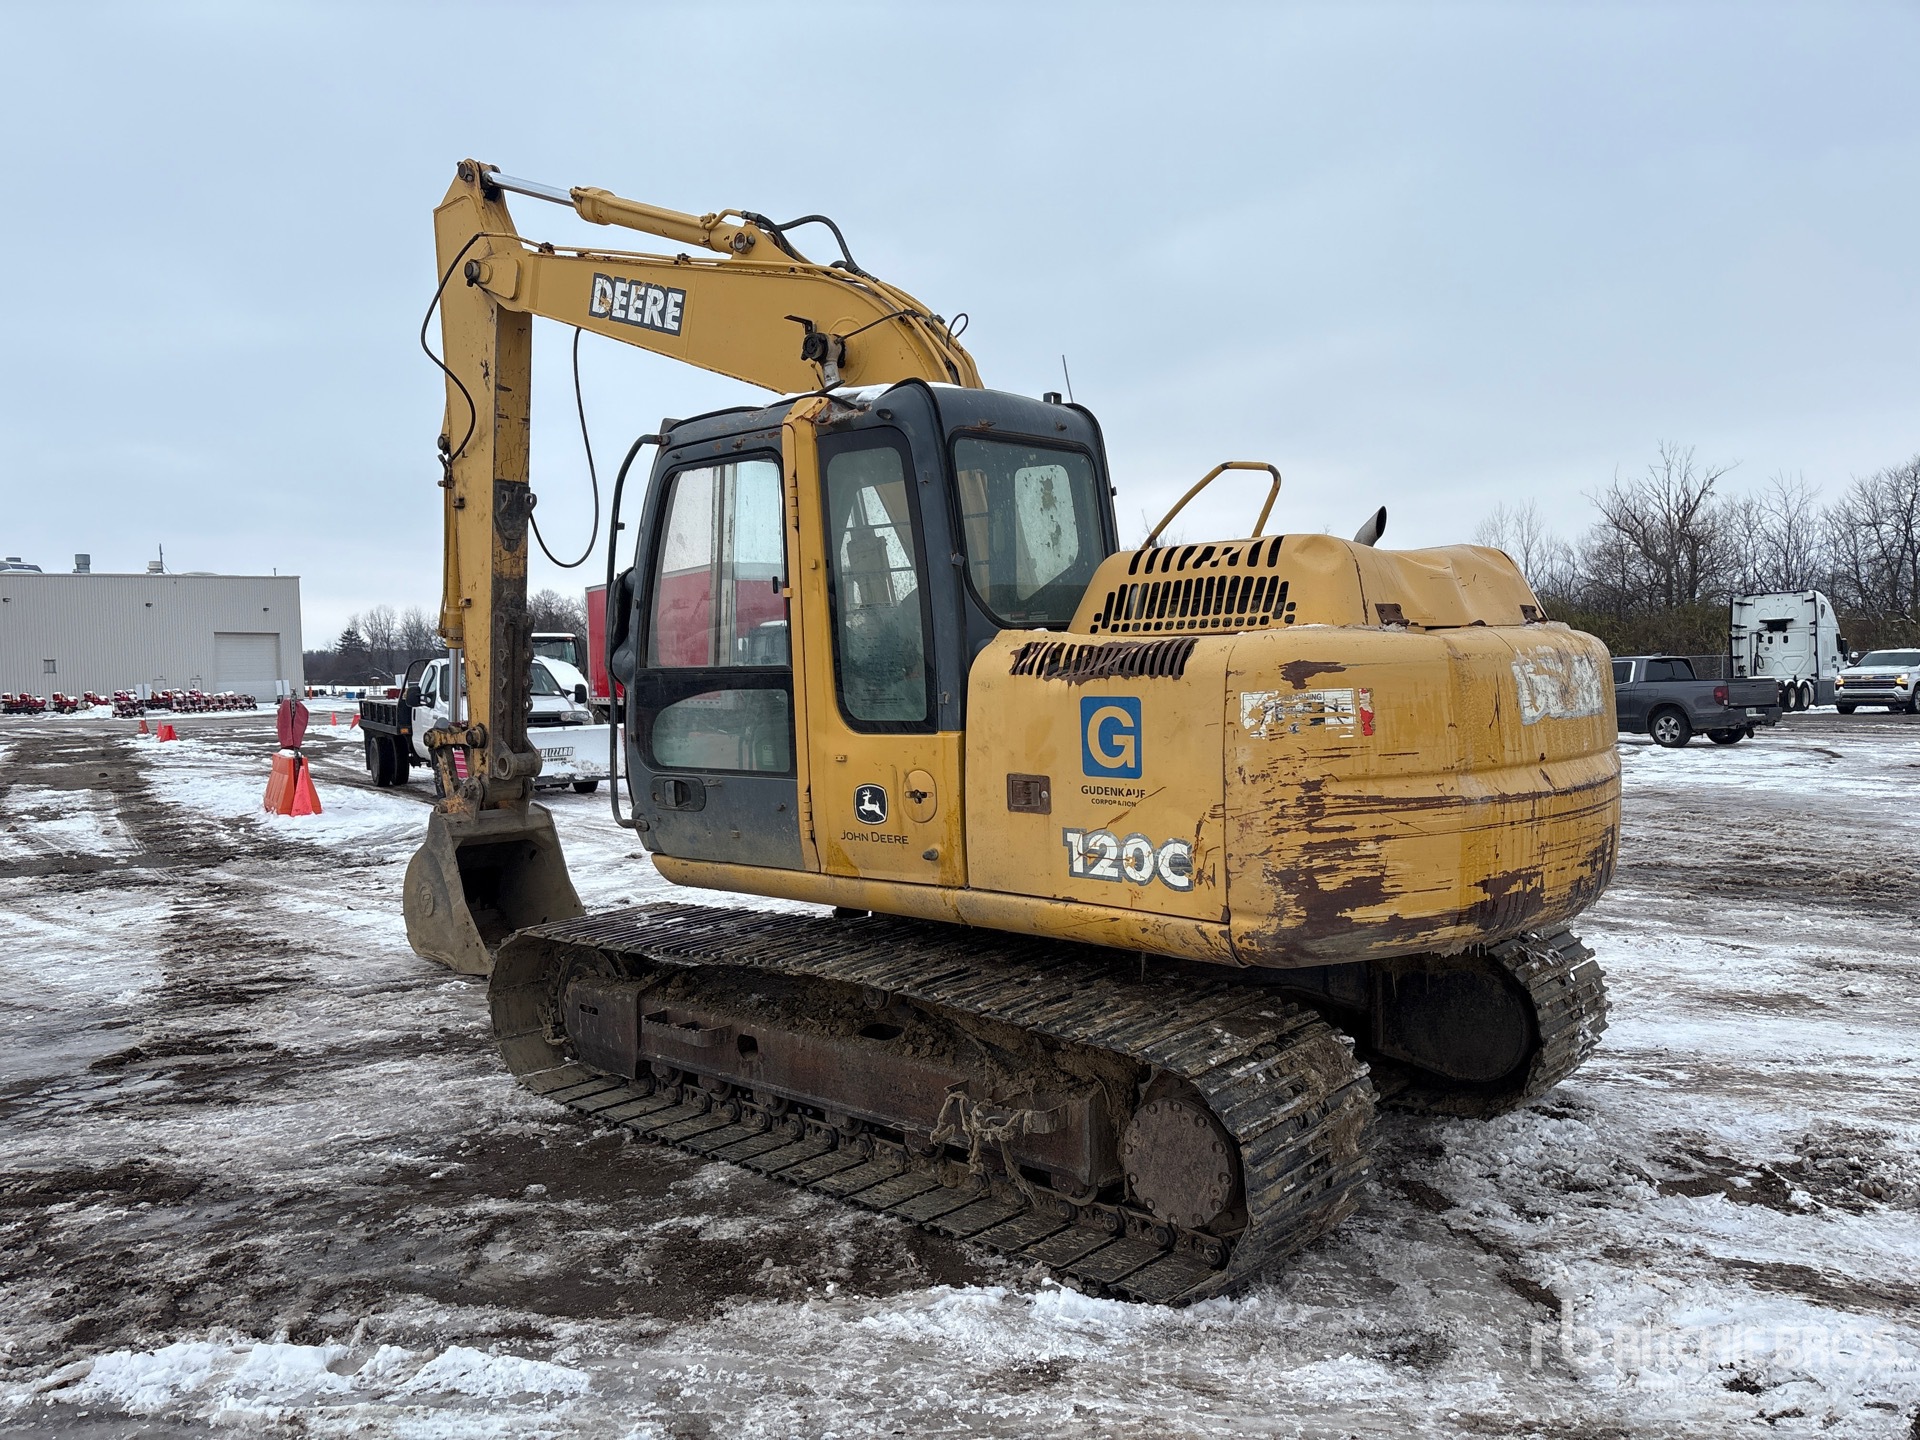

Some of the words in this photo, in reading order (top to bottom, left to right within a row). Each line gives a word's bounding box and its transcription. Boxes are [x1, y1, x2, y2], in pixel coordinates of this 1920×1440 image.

[591, 276, 683, 331] DEERE
[1284, 692, 1322, 701] ARNING
[1087, 705, 1135, 769] G
[540, 747, 574, 758] BLIZZARD
[1080, 785, 1146, 799] GUDENKAUF
[840, 830, 869, 841] JOHN
[871, 831, 909, 844] DEERE
[1066, 831, 1190, 887] 120C
